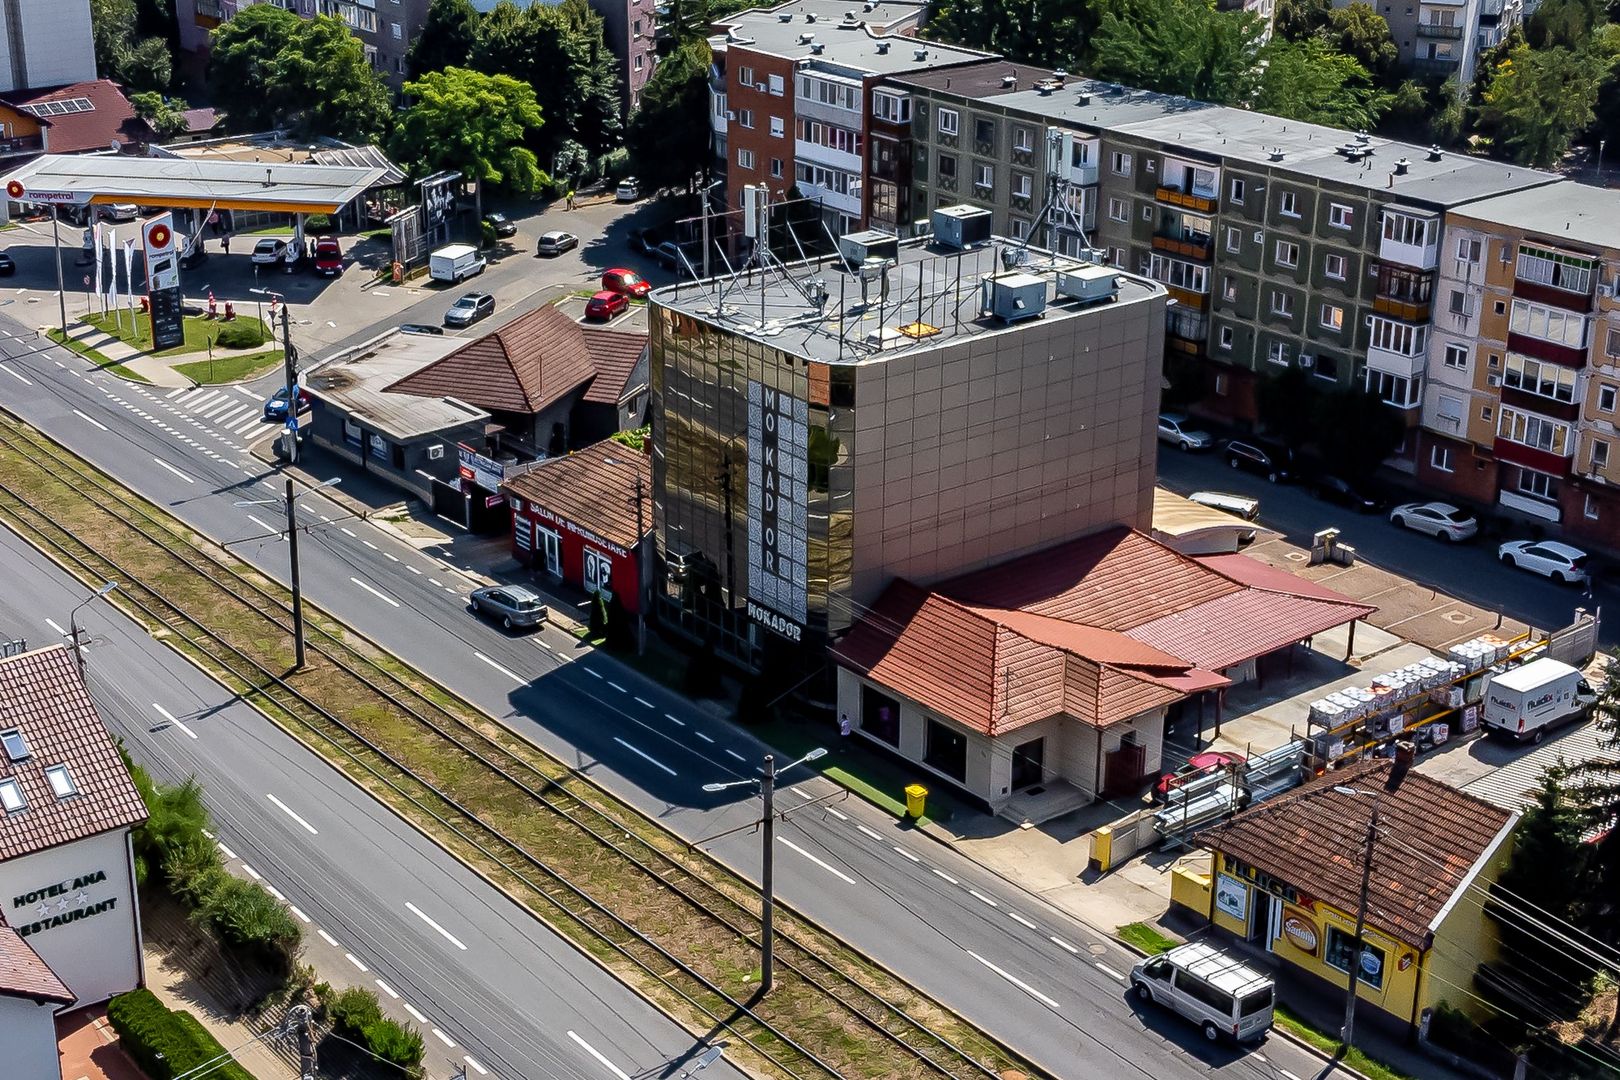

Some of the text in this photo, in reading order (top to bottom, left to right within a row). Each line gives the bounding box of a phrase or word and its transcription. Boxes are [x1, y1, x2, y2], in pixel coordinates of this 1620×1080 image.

[29, 192, 74, 200] rompetrol
[748, 602, 801, 641] MOKADOR
[13, 871, 107, 908] HOTEL ANA
[17, 897, 117, 937] ESTAURANT
